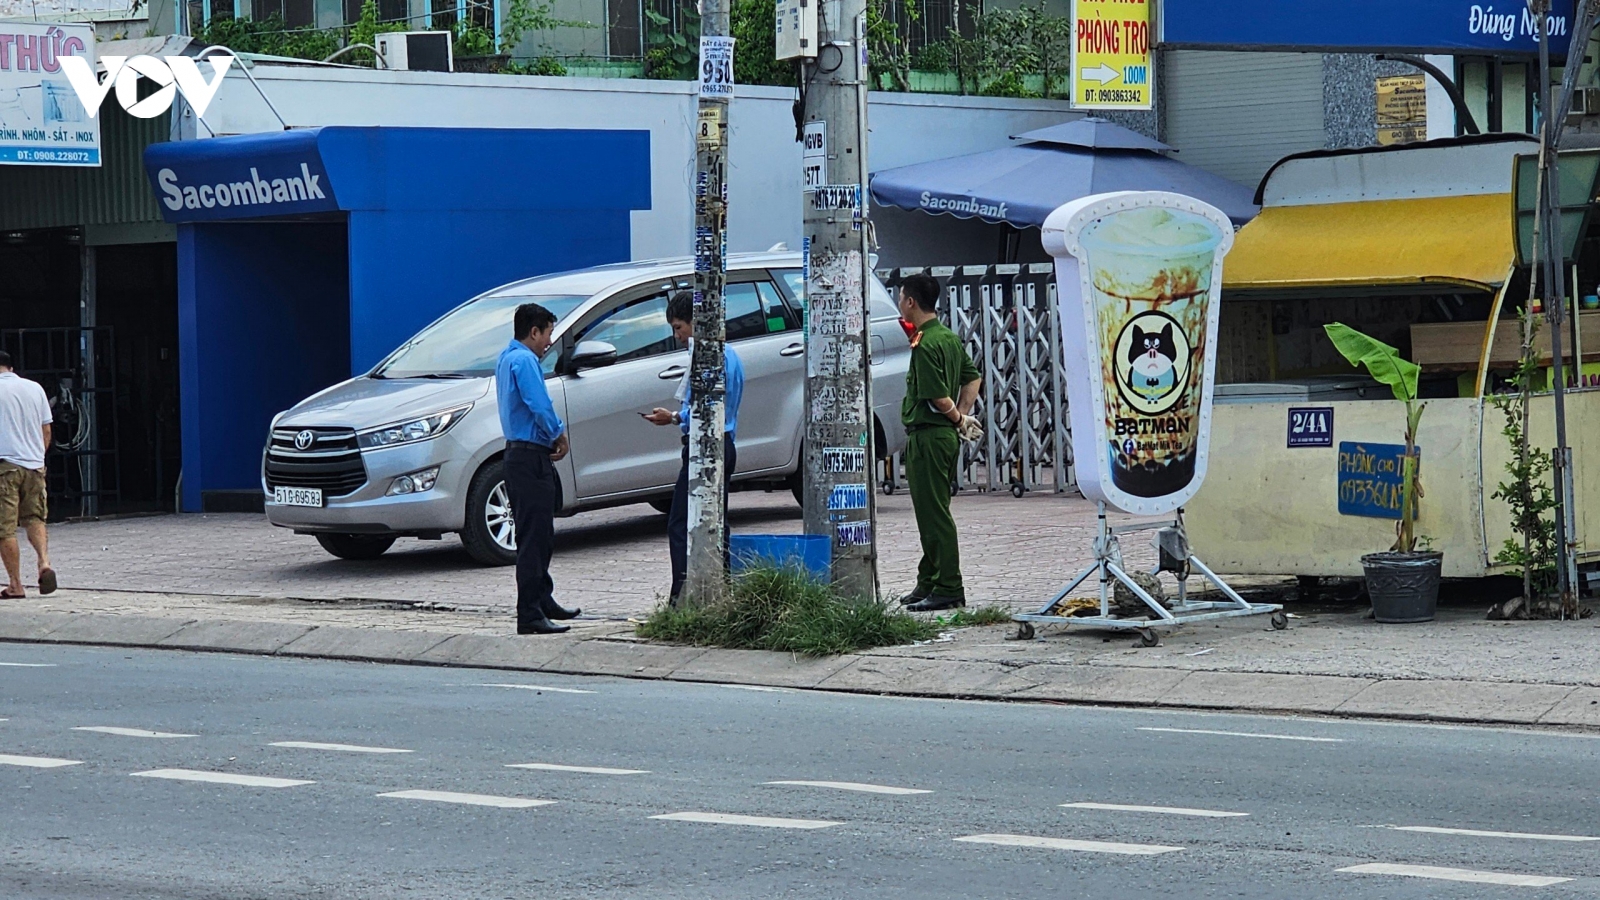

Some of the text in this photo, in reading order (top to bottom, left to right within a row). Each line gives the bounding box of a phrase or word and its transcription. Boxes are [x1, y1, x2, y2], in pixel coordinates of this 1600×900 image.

[1469, 5, 1515, 41] Đúng
[1077, 10, 1148, 62] PHÒNG TRỌ
[1123, 66, 1146, 84] 100M
[1085, 89, 1141, 102] ĐT: 0903863342
[75, 131, 94, 142] INOX
[17, 151, 89, 161] ĐT: 0908.228072
[158, 162, 326, 211] Sacombank
[920, 190, 1008, 219] Sacombank
[1293, 412, 1327, 433] 2/4A
